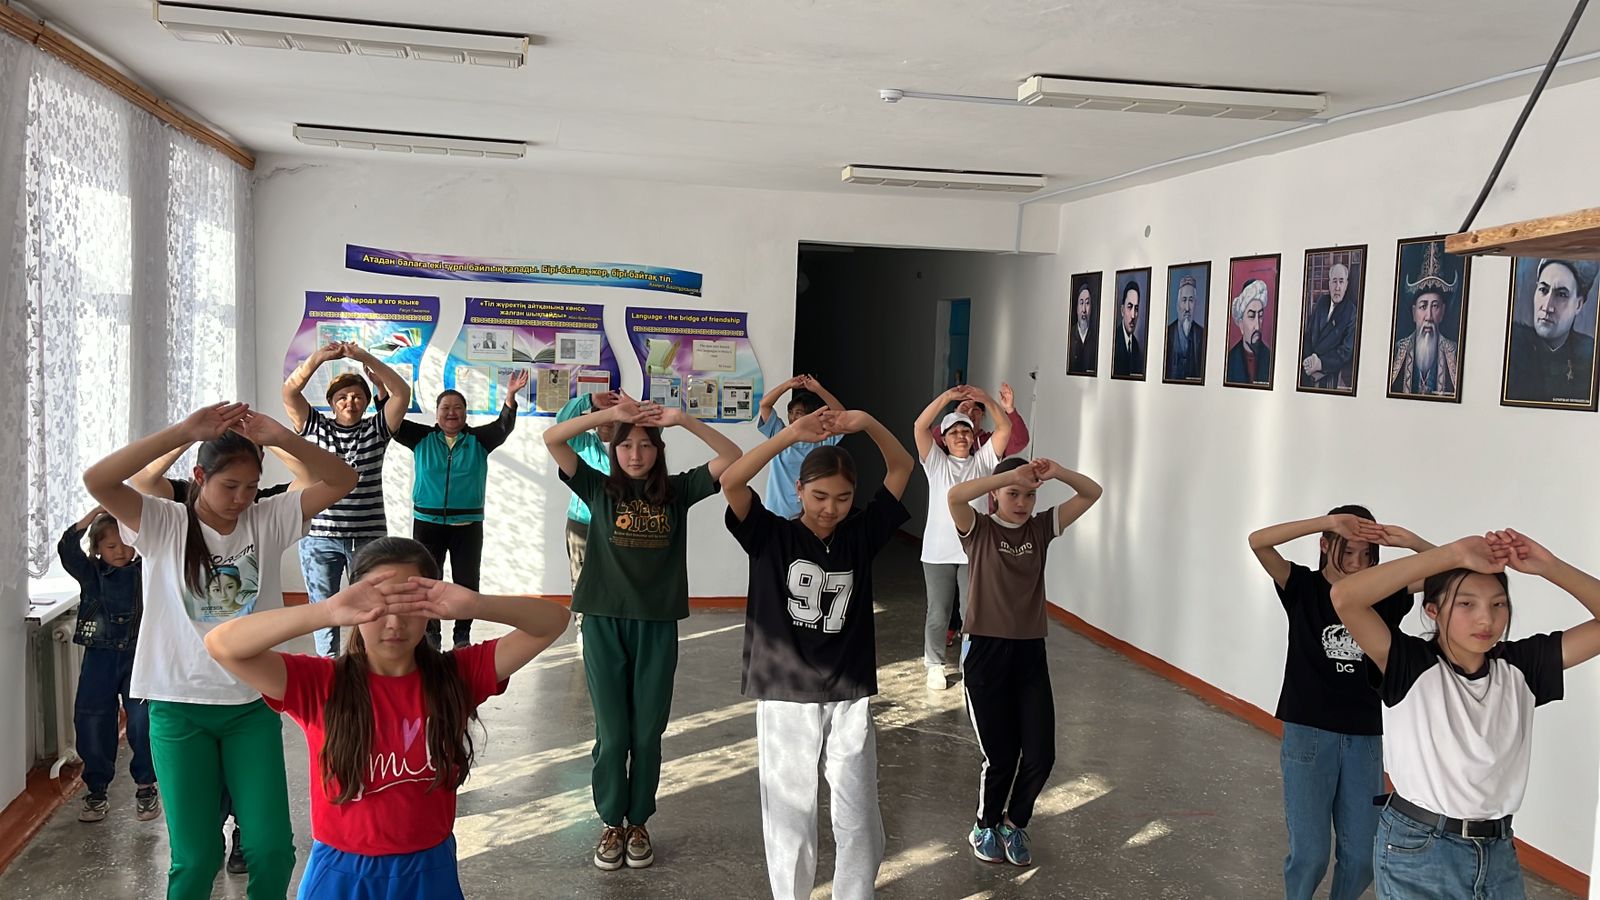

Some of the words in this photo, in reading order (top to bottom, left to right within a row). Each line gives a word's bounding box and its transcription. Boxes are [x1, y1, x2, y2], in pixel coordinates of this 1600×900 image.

[363, 254, 395, 265] Атадан
[397, 258, 428, 268] балаға
[429, 261, 443, 269] екі
[468, 263, 504, 273] байлық
[504, 265, 539, 274] қалады.
[541, 264, 589, 276] Бірі-байтақ
[590, 268, 610, 279] жер,
[611, 268, 657, 281] бірі-байтақ
[659, 275, 673, 283] тіл.
[325, 295, 349, 304] Жизнь
[350, 297, 377, 305] народа
[631, 312, 663, 321] Language
[679, 314, 700, 323] bridge
[708, 316, 741, 324] friendship
[786, 558, 854, 633] 97
[1336, 662, 1355, 674] DG
